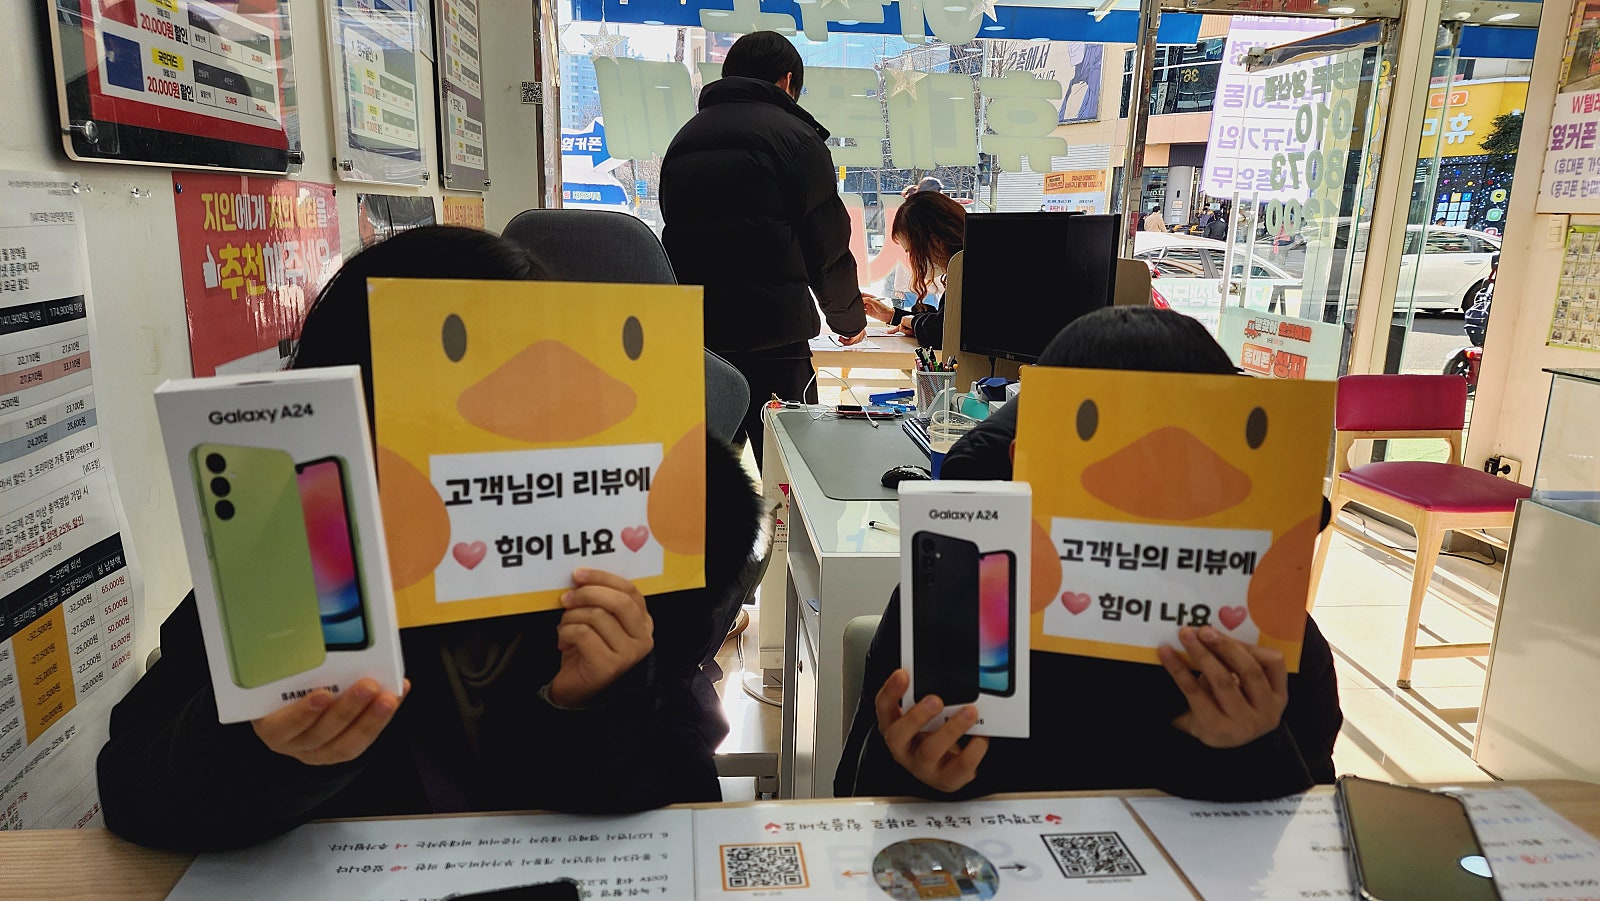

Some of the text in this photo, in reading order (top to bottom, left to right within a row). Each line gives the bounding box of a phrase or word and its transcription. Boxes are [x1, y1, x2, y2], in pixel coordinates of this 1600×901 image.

[140, 13, 174, 41] 20,000원
[174, 24, 188, 45] 할인
[1008, 43, 1051, 70] 2층에서
[147, 75, 194, 102] 20,000원 할인
[562, 136, 602, 152] 옆커폰
[1551, 120, 1598, 151] 옆커폰
[1555, 157, 1584, 175] (휴대폰
[201, 192, 266, 231] 지인에게
[219, 238, 331, 300] 추천해주세요
[208, 403, 314, 425] Galaxy A24
[444, 467, 650, 506] 고객님의 리뷰에
[929, 510, 999, 522] Galaxy A24
[495, 528, 616, 568] 힘이 나요
[1059, 538, 1257, 575] 고객님의 리뷰에
[102, 574, 125, 594] 65,000원
[71, 615, 96, 636] -27,500원
[104, 596, 128, 616] 55,000원
[1098, 593, 1212, 627] 힘이 나요
[74, 634, 98, 655] -25,000원
[108, 614, 130, 634] 50,000원
[77, 652, 101, 673] -22,500원
[110, 632, 131, 651] 45,000원
[281, 684, 340, 701] SAMG
[871, 819, 918, 830] 리뷰로
[926, 816, 971, 829] 소중한
[981, 814, 1043, 825] 고객님의
